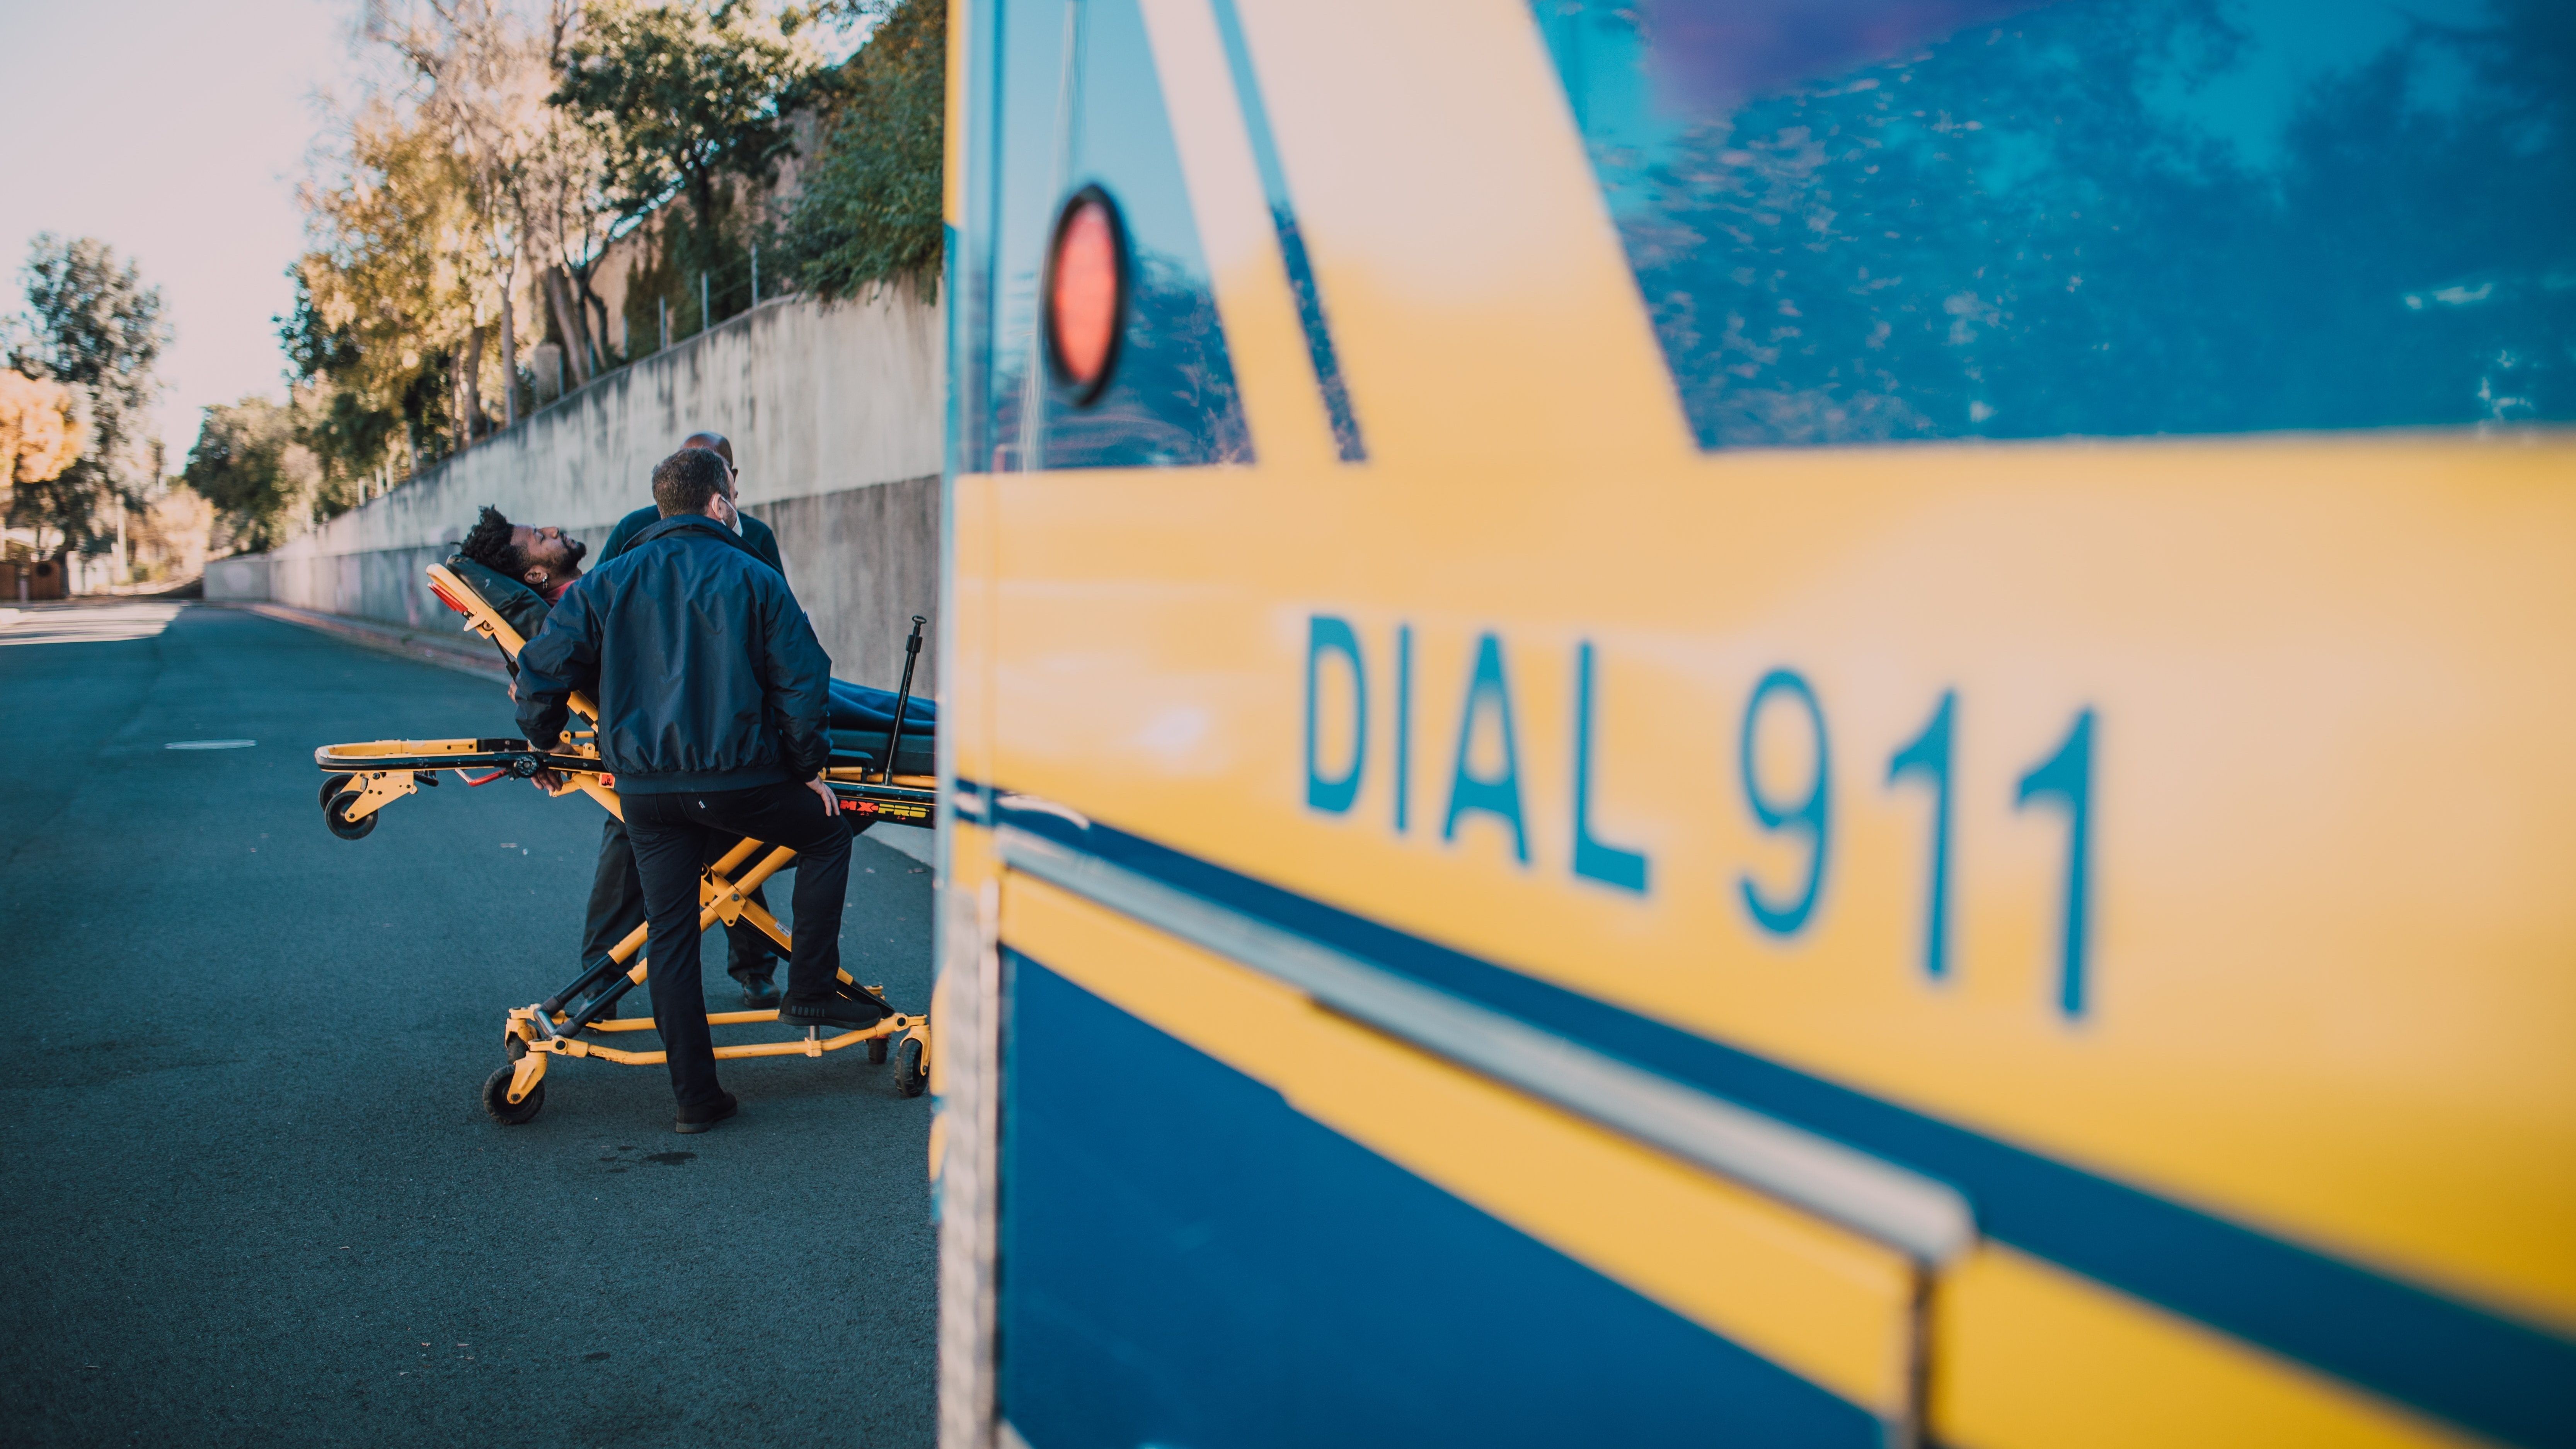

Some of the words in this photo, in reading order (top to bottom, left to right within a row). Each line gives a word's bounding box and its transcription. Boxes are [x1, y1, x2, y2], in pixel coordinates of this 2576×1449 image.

[840, 799, 927, 818] MX-PRO
[1302, 612, 1654, 901] DIAL
[1735, 662, 2104, 1025] 911
[791, 1005, 826, 1017] NOBULL
